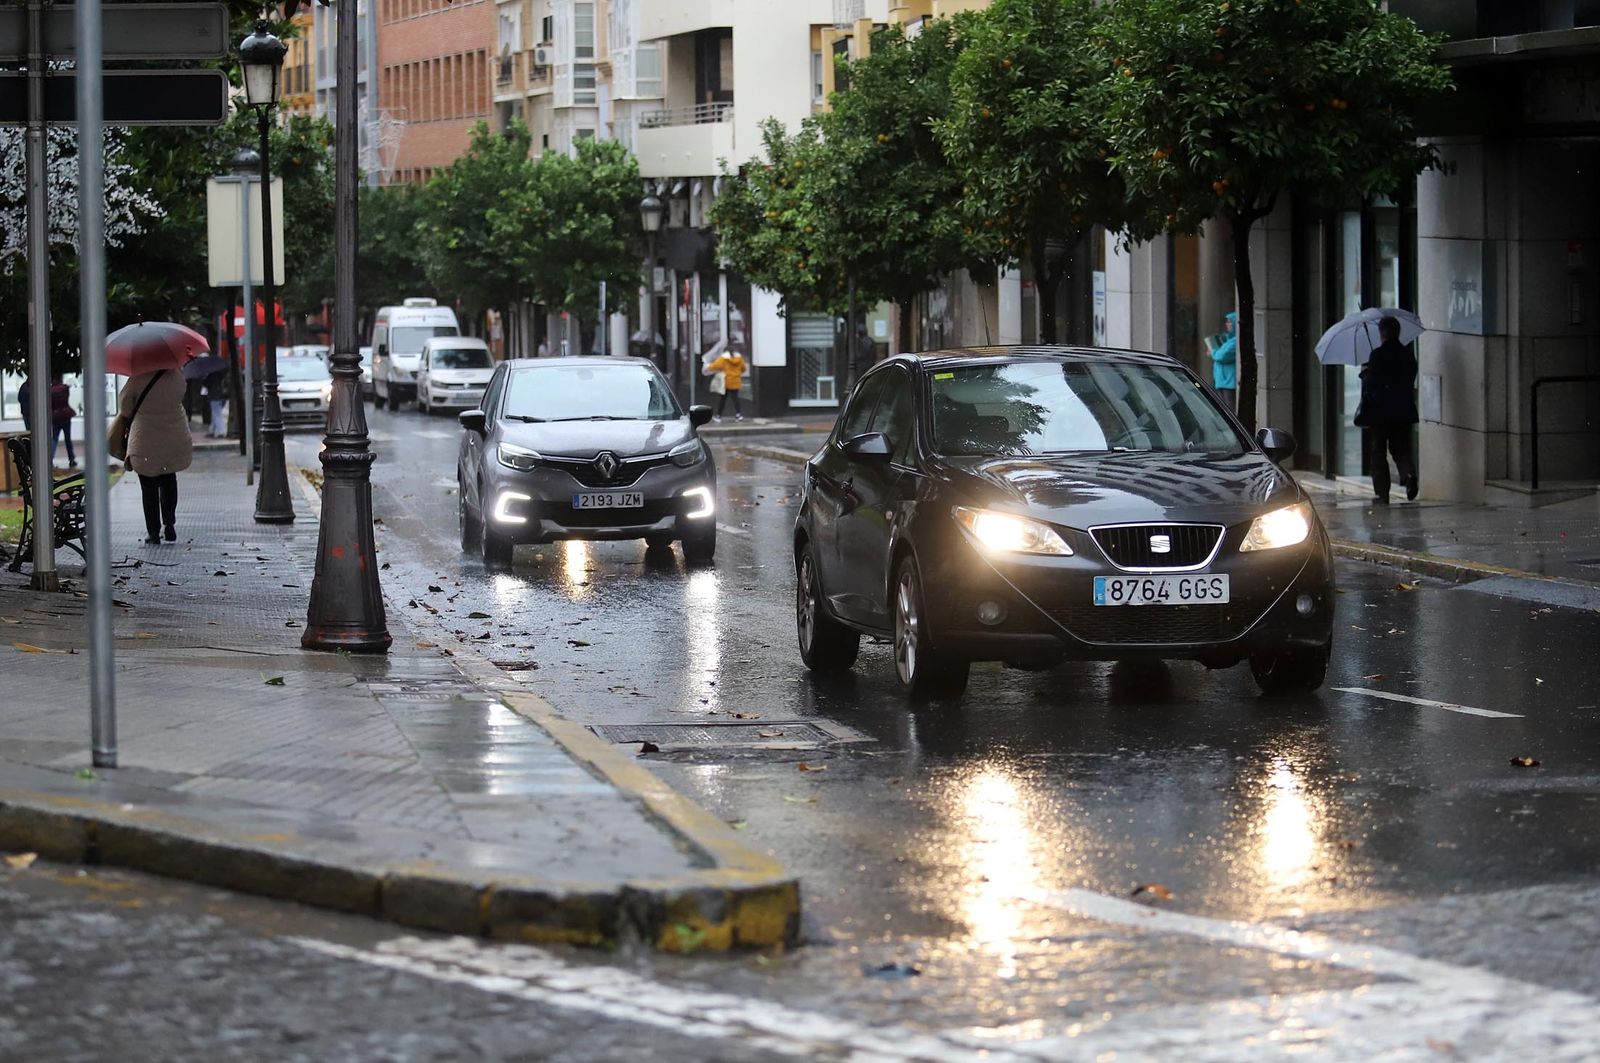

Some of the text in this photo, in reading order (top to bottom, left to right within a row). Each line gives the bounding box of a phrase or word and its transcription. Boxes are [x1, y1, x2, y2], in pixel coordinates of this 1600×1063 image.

[581, 493, 641, 507] 2193 JZM
[1110, 579, 1170, 601] 8764
[1179, 577, 1223, 600] GGS
